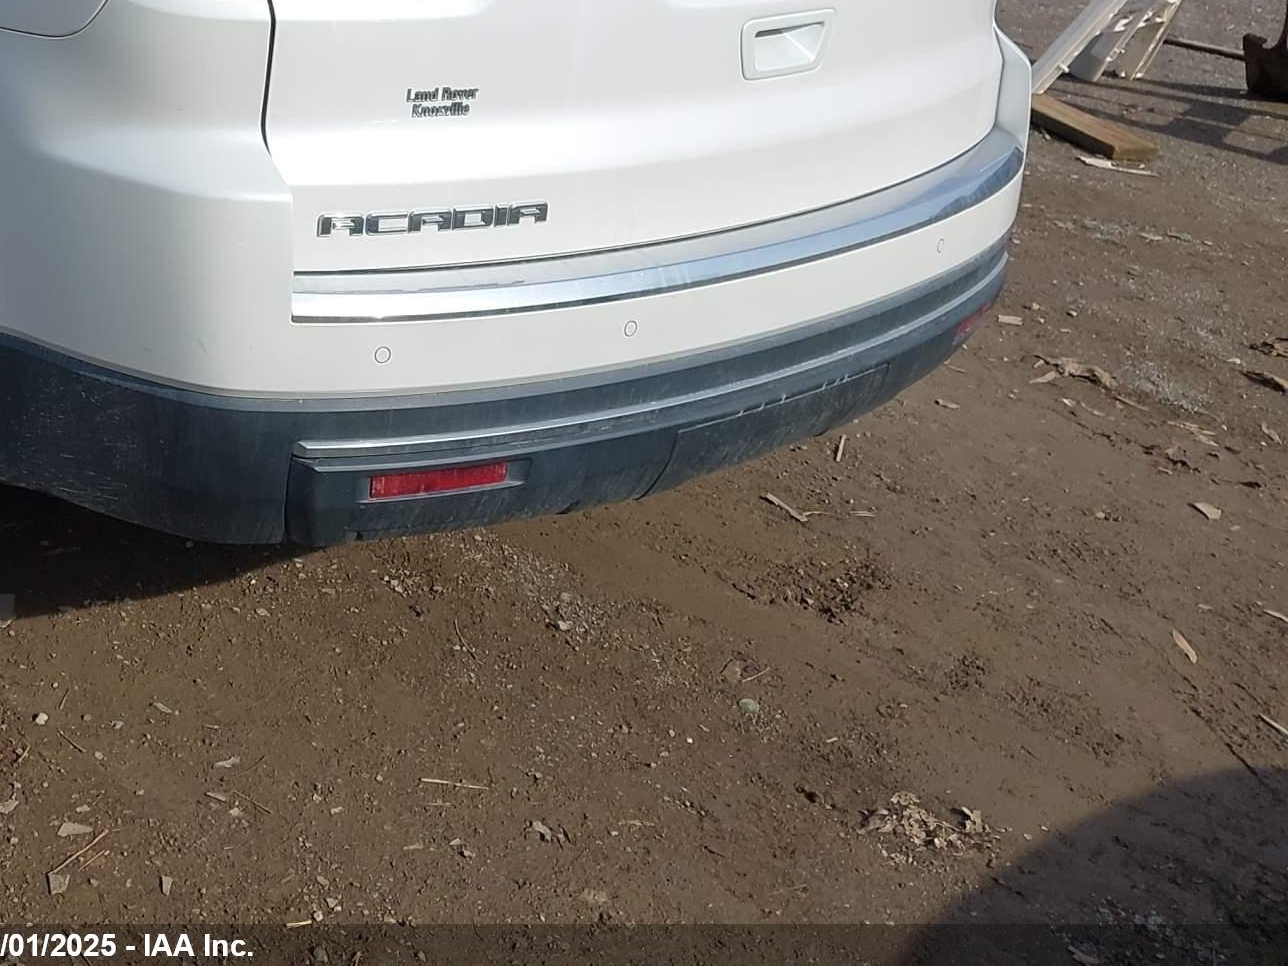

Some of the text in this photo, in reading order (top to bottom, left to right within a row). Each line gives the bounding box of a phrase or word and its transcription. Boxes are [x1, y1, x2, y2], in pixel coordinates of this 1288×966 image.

[406, 86, 479, 103] Land Rover
[411, 101, 470, 118] Knoxville
[316, 200, 549, 238] ACADIA
